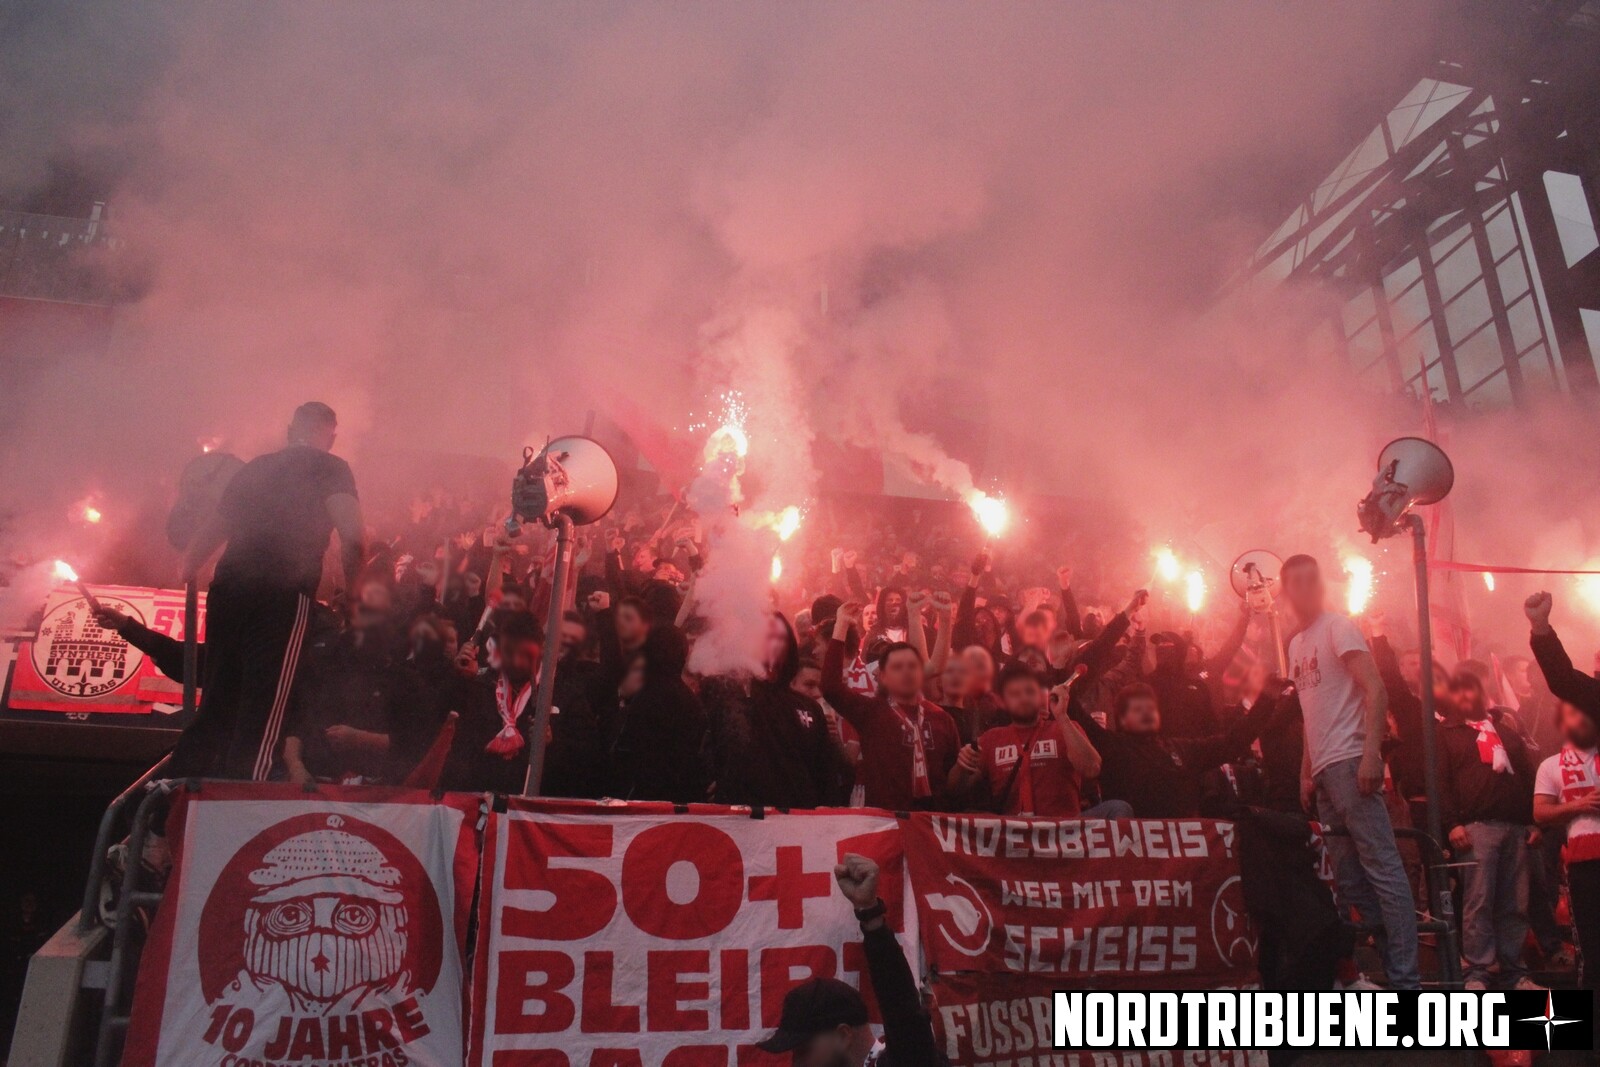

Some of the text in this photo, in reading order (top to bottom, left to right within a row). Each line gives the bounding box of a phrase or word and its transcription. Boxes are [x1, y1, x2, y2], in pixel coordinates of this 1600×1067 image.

[50, 650, 126, 662] SYNTHESIA
[931, 815, 1208, 859] VIDEOBEWEIS
[1001, 880, 1192, 909] WEG MIT DEM
[1003, 924, 1197, 973] SCHEISS
[202, 1004, 255, 1053] 10
[264, 997, 431, 1060] JAHRE
[939, 996, 1052, 1060] FUSSB
